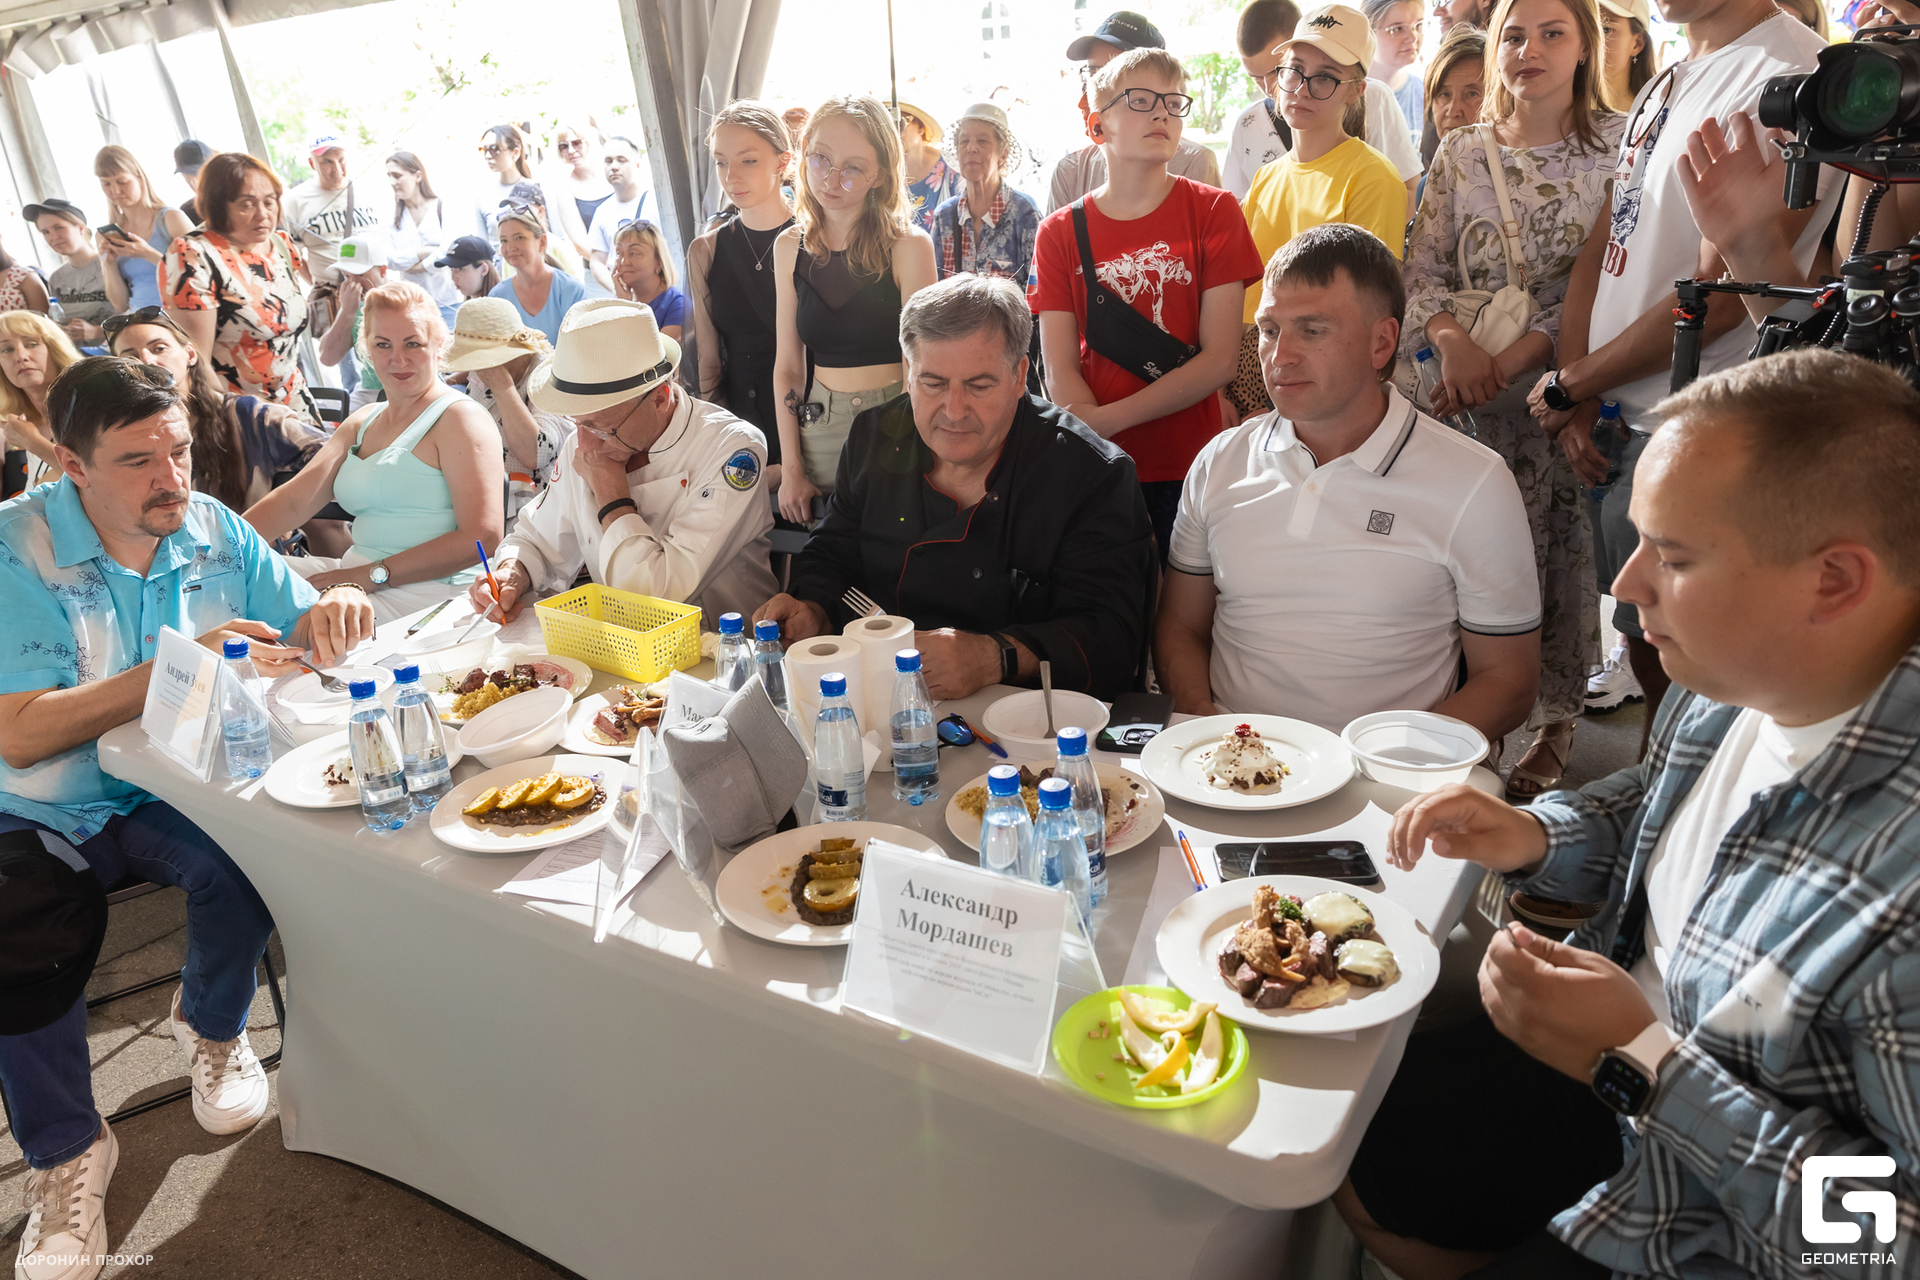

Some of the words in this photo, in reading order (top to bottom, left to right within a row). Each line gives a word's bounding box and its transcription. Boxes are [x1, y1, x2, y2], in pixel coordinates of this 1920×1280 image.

[308, 207, 378, 235] STRNG
[165, 661, 190, 684] Андрей
[188, 673, 206, 693] Зуев
[900, 878, 1018, 928] Александр
[896, 908, 1013, 958] Мордашев
